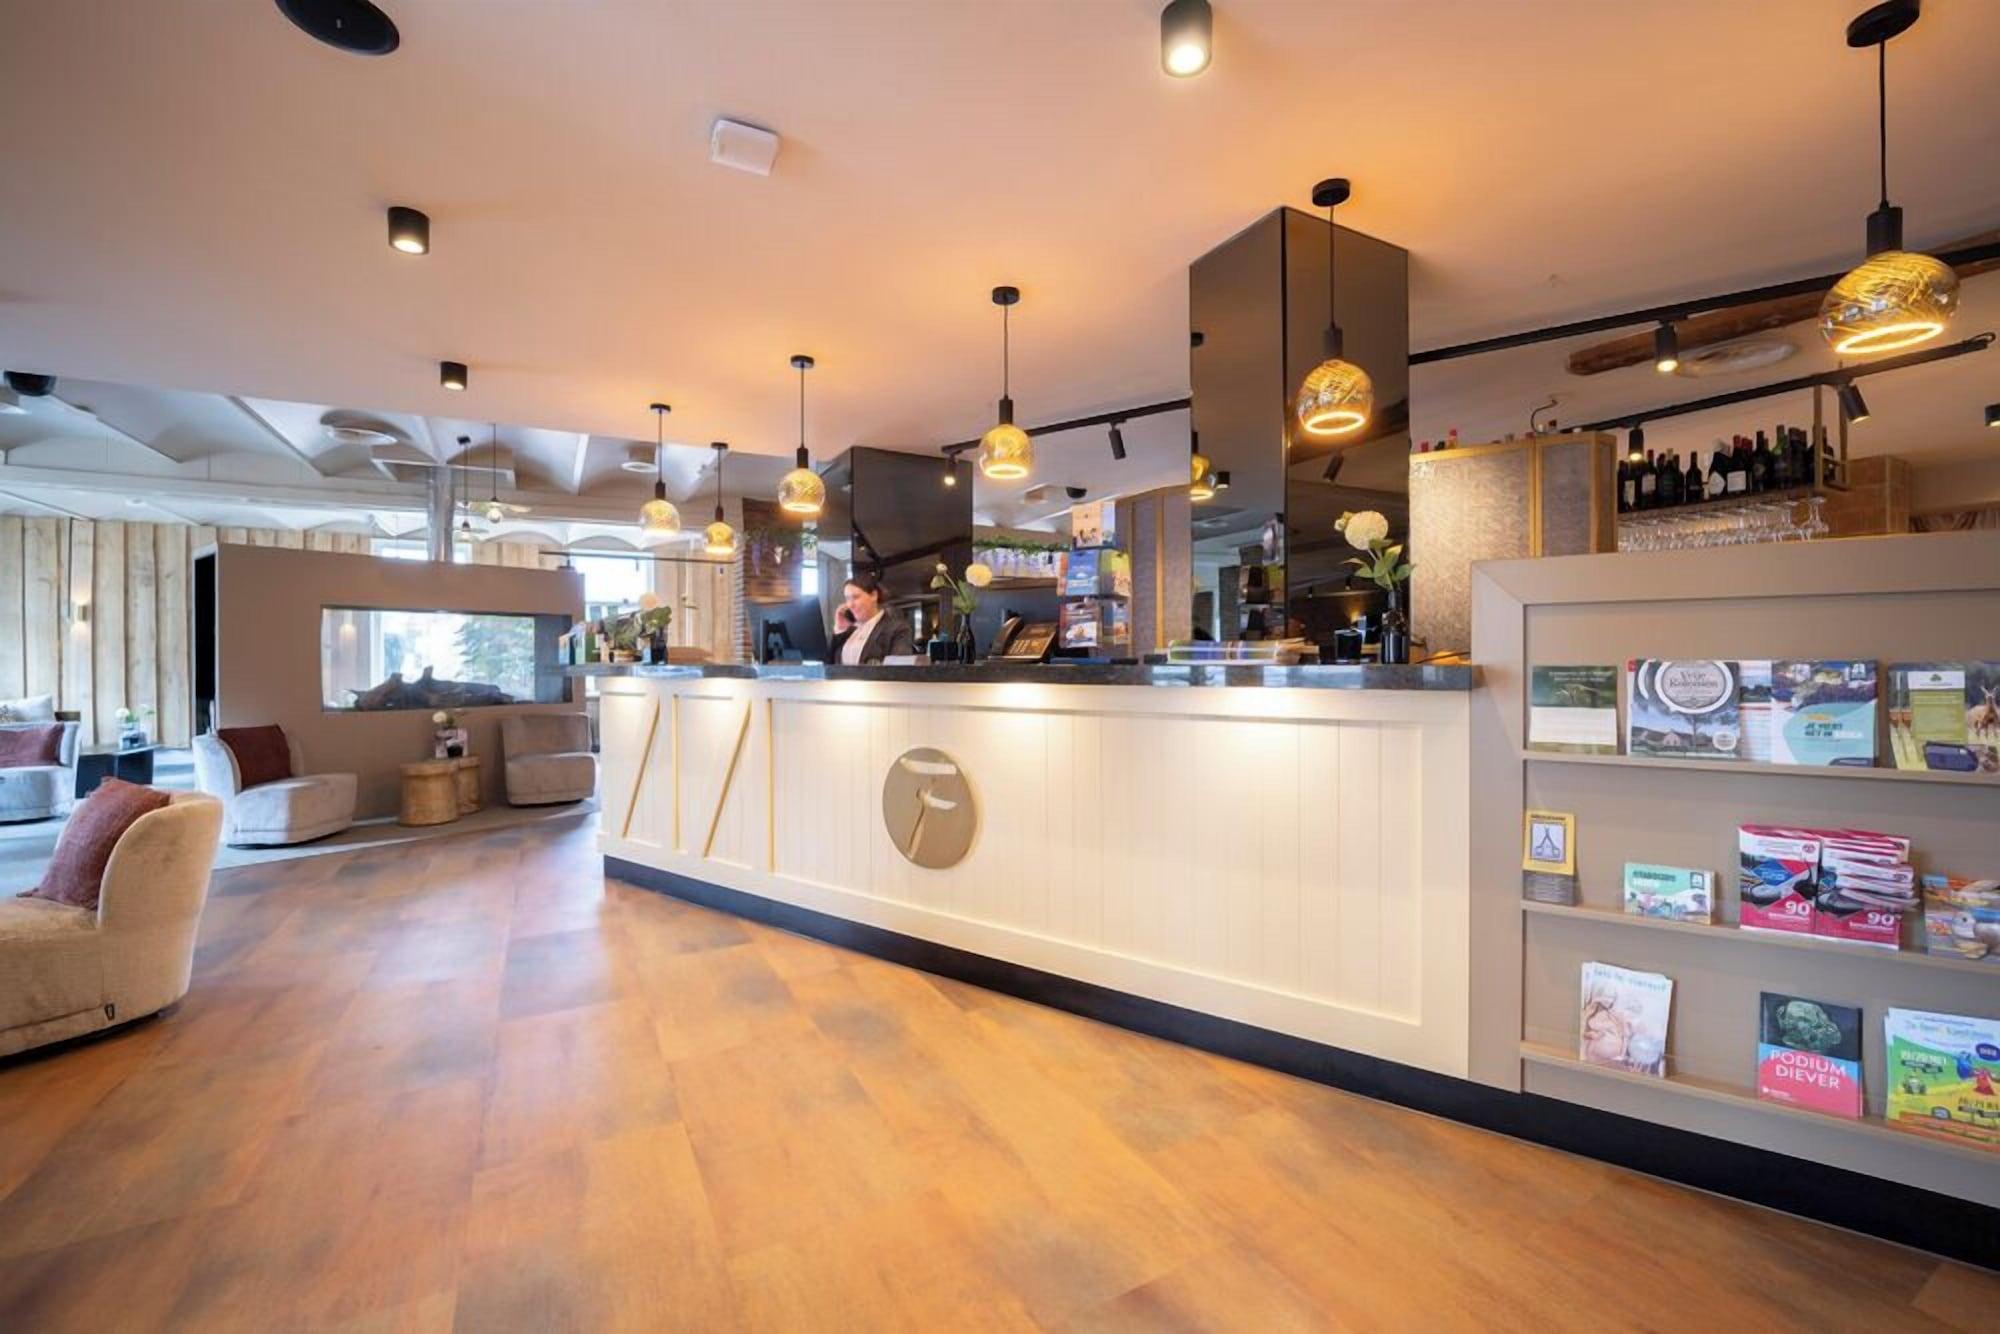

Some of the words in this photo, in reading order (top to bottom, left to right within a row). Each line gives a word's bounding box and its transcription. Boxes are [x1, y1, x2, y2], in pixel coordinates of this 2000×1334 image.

[1785, 900, 1810, 916] 90
[1867, 911, 1895, 926] 90
[1771, 1049, 1847, 1077] PODIUM
[1775, 1064, 1841, 1090] DIEVER
